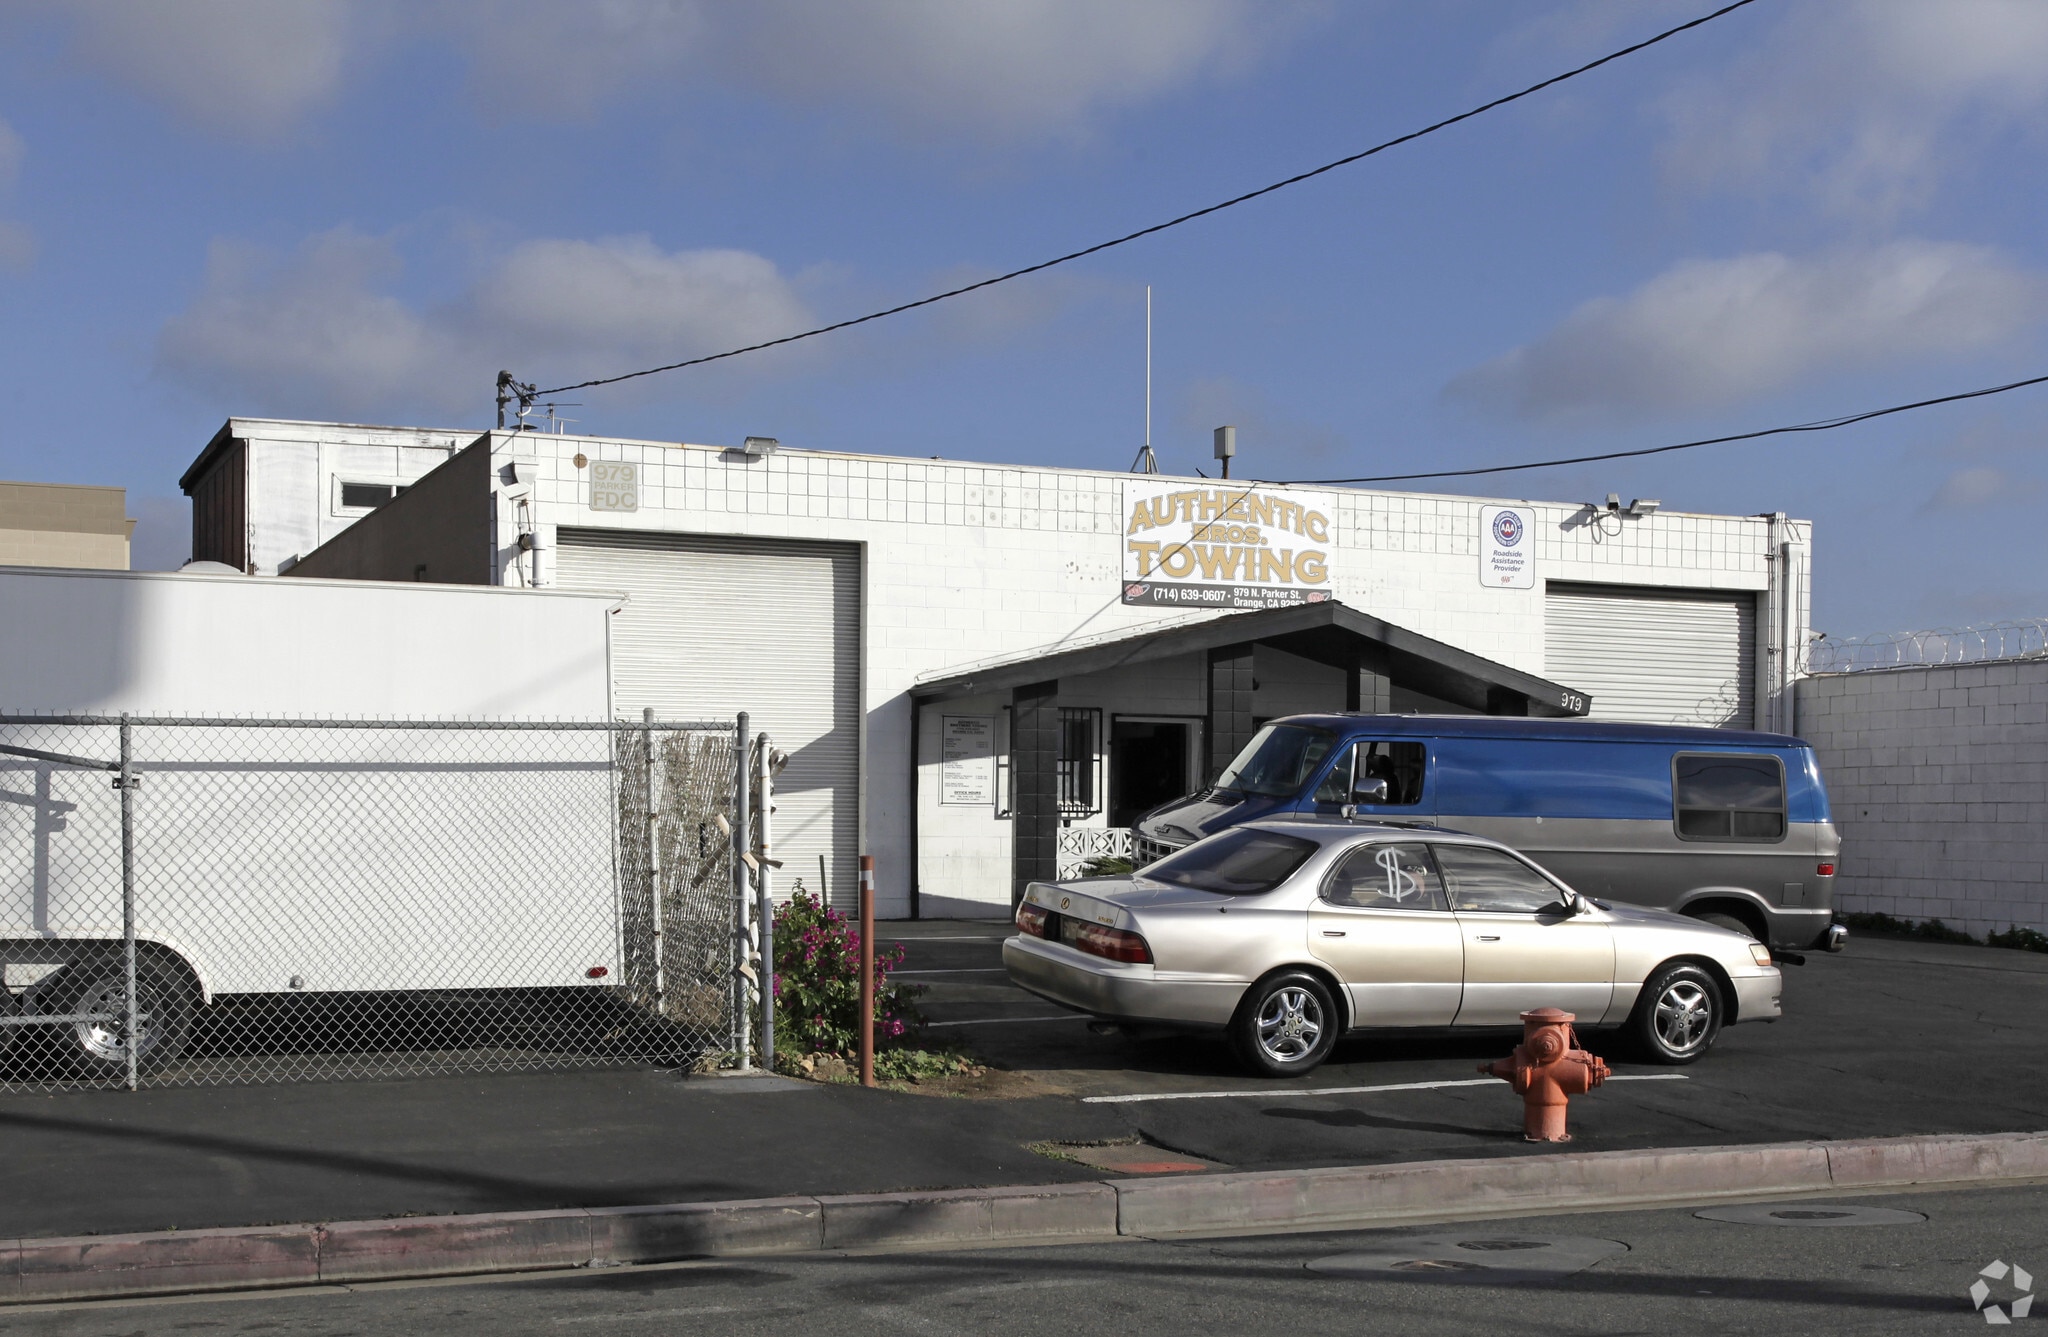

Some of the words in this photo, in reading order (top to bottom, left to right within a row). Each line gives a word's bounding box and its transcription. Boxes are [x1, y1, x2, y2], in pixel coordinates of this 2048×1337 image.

[594, 464, 635, 481] 979
[594, 481, 634, 491] PARKER
[593, 491, 636, 508] FDC
[1127, 489, 1330, 544] AUTHENTIC
[1191, 522, 1269, 545] BROS.
[1501, 523, 1515, 532] AAA
[1491, 557, 1525, 565] Assistance
[1493, 550, 1523, 558] Roadside
[1127, 539, 1329, 585] TOWING
[1153, 587, 1179, 602] (714)
[1180, 588, 1227, 601] 639-0607
[1233, 587, 1250, 597] 979
[1251, 588, 1260, 598] N.
[1261, 588, 1289, 599] Parker
[1290, 590, 1302, 599] St.
[1233, 597, 1266, 609] Orange,
[1267, 598, 1279, 608] CA
[1561, 692, 1582, 711] 979
